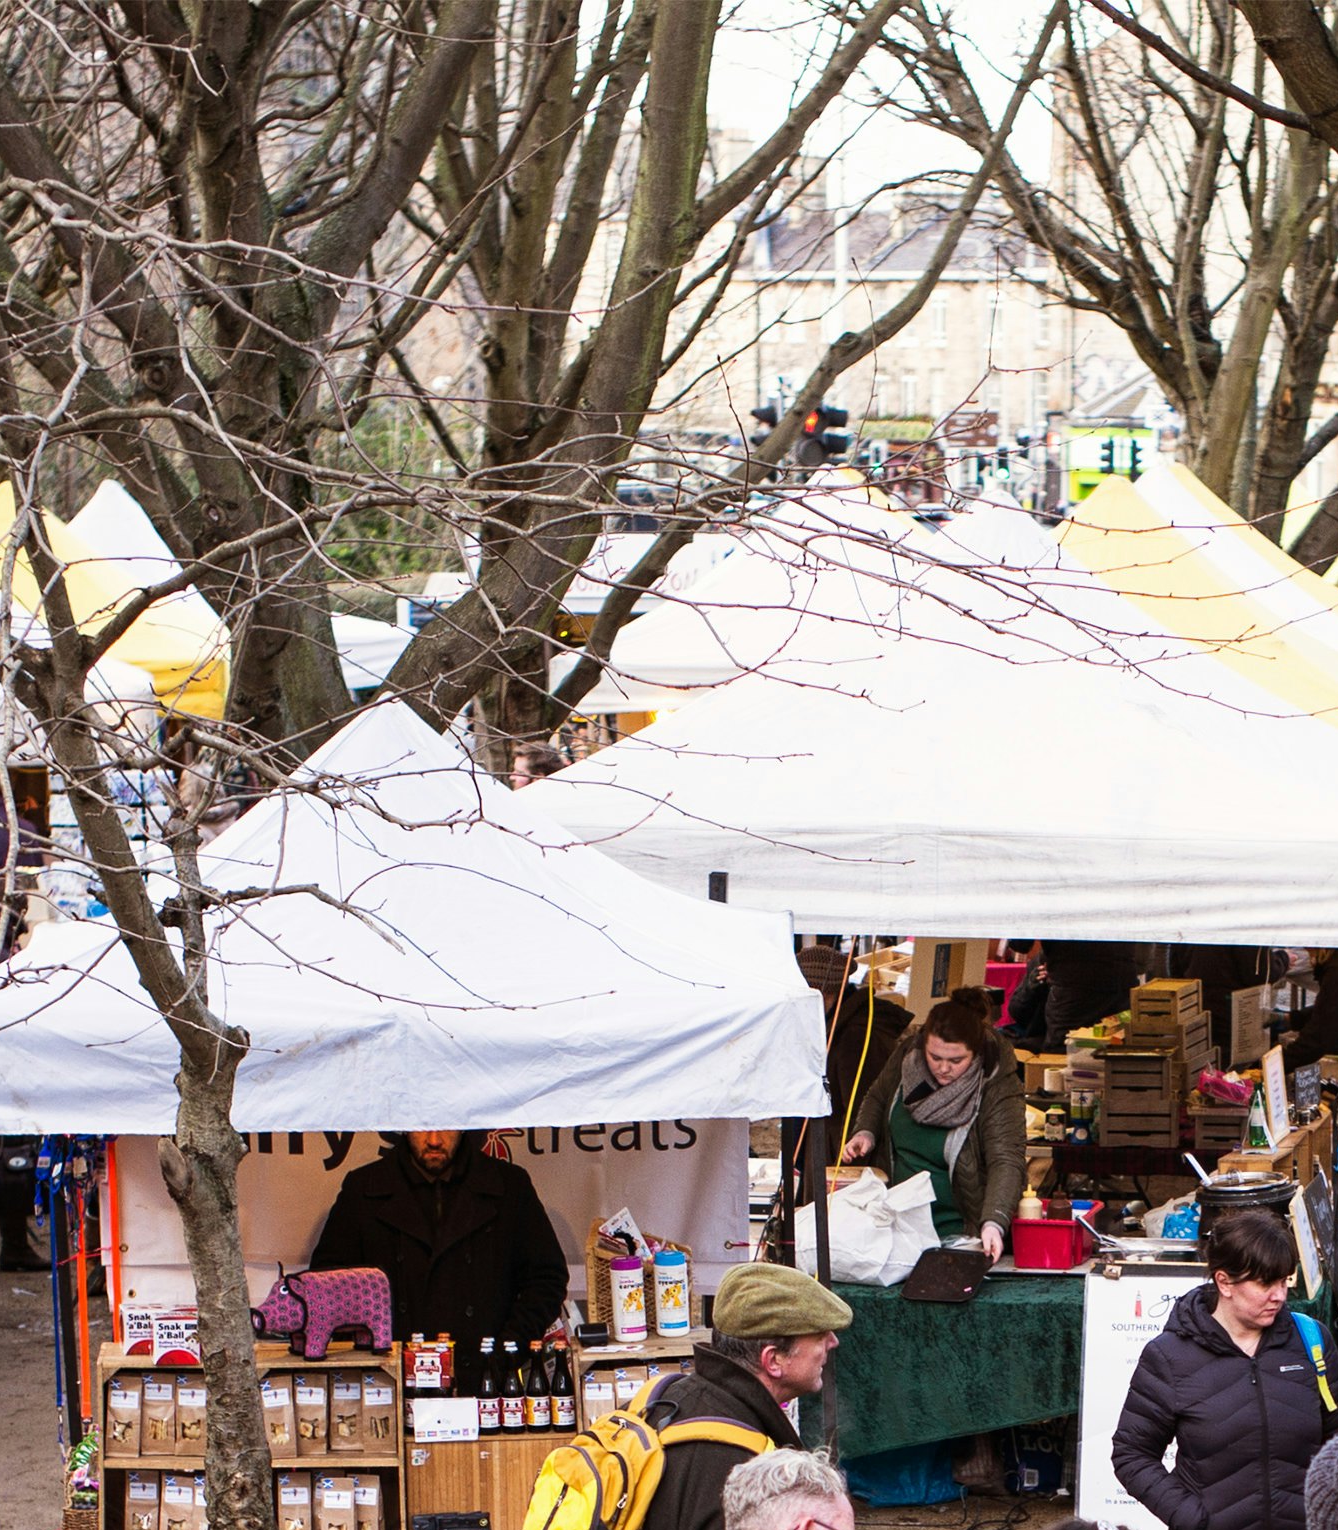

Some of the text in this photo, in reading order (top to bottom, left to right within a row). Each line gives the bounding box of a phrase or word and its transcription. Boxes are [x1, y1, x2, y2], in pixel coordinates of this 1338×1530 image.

[128, 1313, 151, 1321] Snak
[126, 1322, 153, 1330] 'a'Bal
[158, 1323, 182, 1331] Snak
[1111, 1323, 1161, 1332] SOUTHERN
